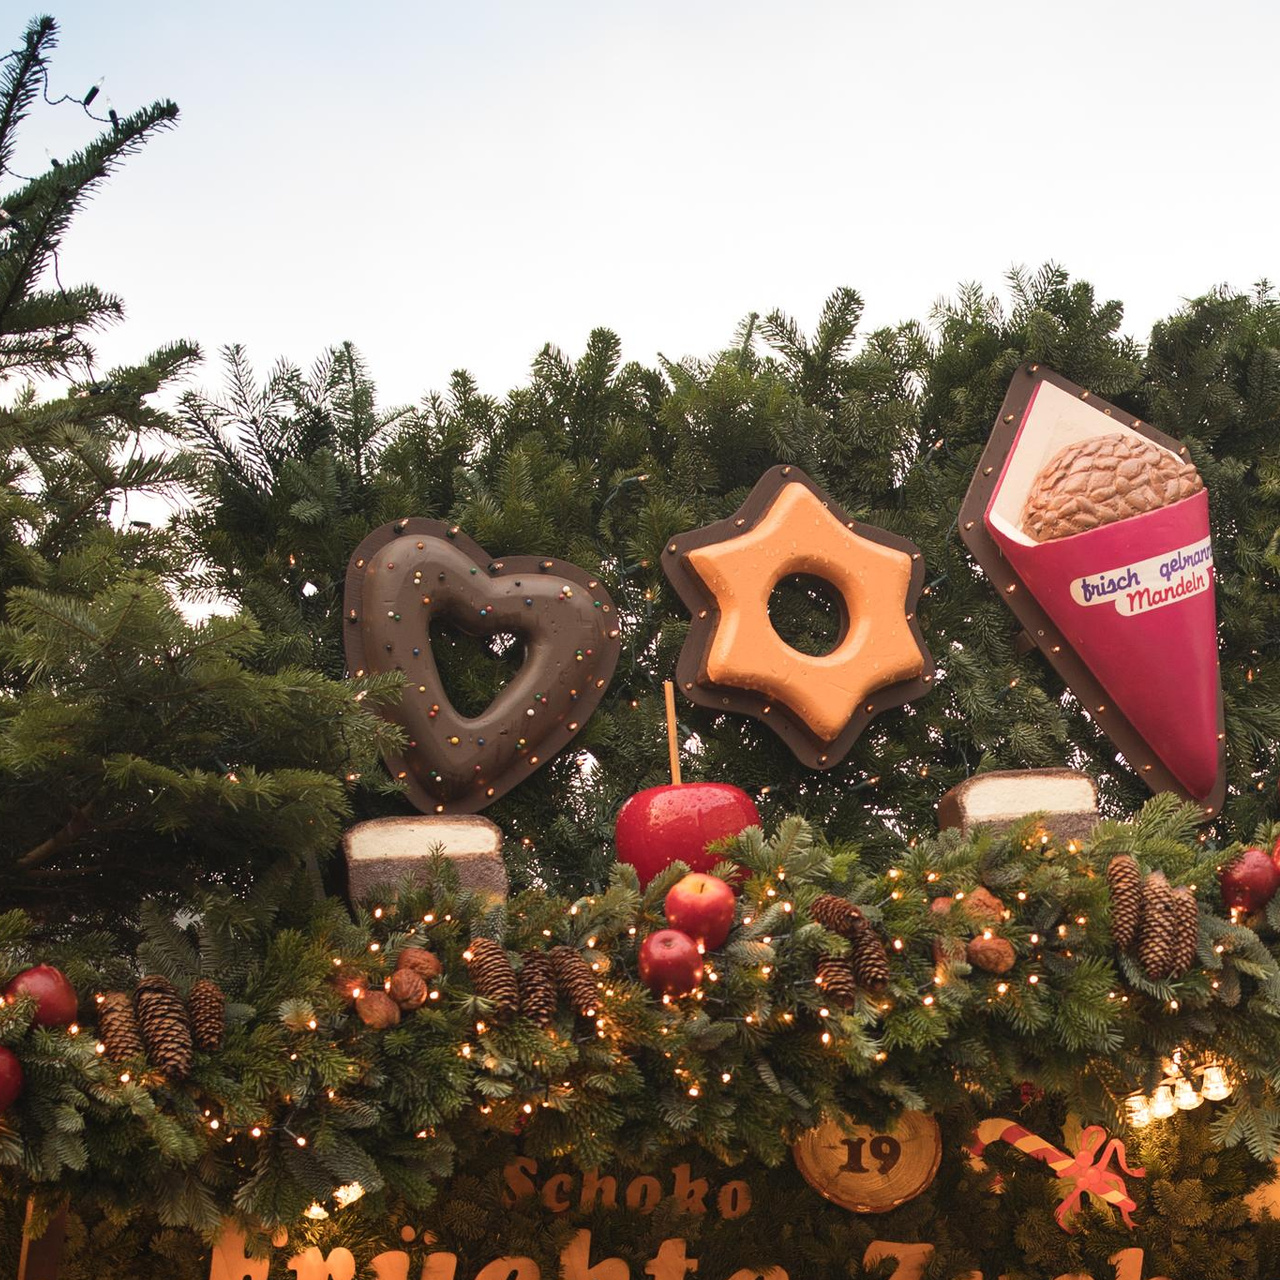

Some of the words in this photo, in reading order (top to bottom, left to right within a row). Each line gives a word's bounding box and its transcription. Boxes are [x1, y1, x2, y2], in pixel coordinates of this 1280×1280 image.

[1081, 568, 1141, 603] frisch
[1126, 572, 1206, 613] Mandeln
[840, 1132, 902, 1176] 19
[502, 1155, 751, 1220] Schoko
